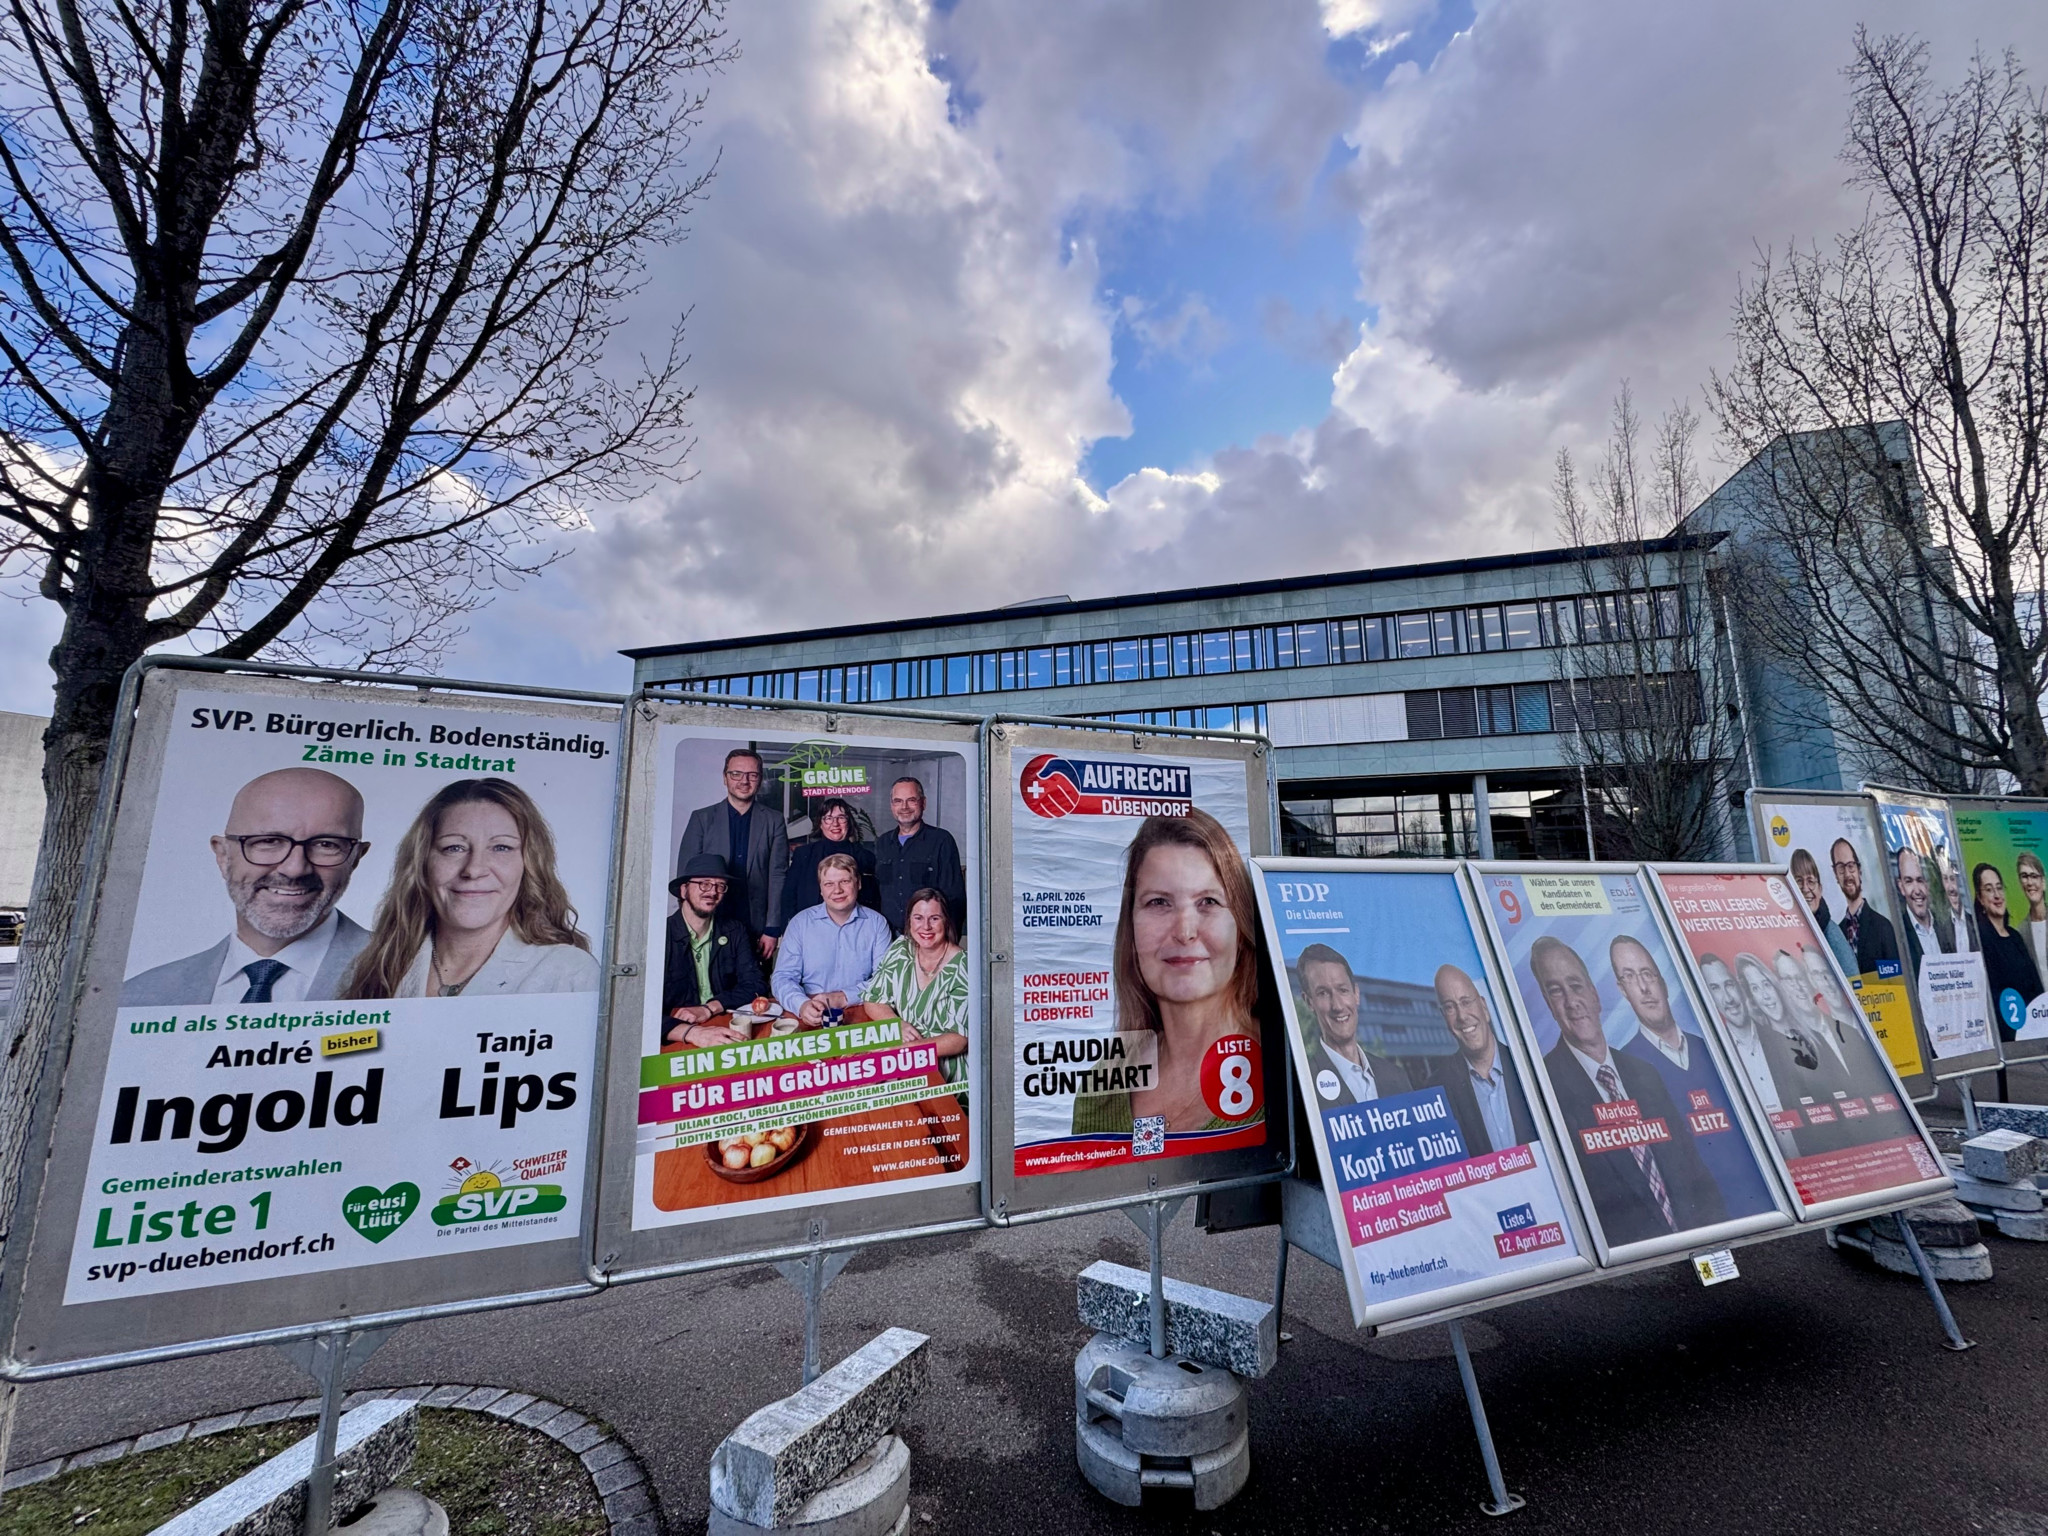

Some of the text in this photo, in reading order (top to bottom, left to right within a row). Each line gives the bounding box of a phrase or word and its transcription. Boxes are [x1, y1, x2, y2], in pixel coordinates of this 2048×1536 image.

[191, 708, 610, 759] SVP. Bürgerlich. Bodenständig.
[302, 744, 516, 772] Zäme in Stadtrat
[804, 767, 864, 784] GRÜNE
[1082, 763, 1188, 793] AUFRECHT
[803, 786, 870, 796] STADT DÜBENDORF
[1102, 795, 1190, 818] DÜBENDORF
[1772, 825, 1788, 836] EVP
[1277, 883, 1330, 902] FDP
[1493, 878, 1513, 887] Liste
[1529, 878, 1596, 887] Wählen Sie unsere
[1610, 888, 1629, 897] EDU
[1770, 882, 1782, 895] SP
[1022, 892, 1086, 901] 12. APRIL 2026
[1541, 889, 1592, 899] Kandidaten in
[1674, 897, 1700, 913] FÜR
[1700, 900, 1721, 913] EIN
[1722, 897, 1769, 912] LEBENS-
[1022, 904, 1092, 914] WIEDER IN DEN
[1285, 909, 1344, 920] Die Liberalen
[1499, 889, 1522, 924] 9
[1540, 901, 1555, 910] den
[1023, 915, 1103, 927] GEMEINDERAT
[1680, 913, 1804, 932] WERTES DÜBENDORF.
[1023, 972, 1109, 987] KONSEQUENT
[1879, 964, 1899, 975] Liste 7
[1023, 988, 1109, 1005] FREIHEITLICH
[130, 1009, 391, 1034] und als Stadtpräsident
[1023, 1006, 1093, 1022] LOBBYFREI
[2009, 1003, 2019, 1023] 2
[327, 1034, 374, 1051] bisher
[476, 1028, 554, 1055] Tanja
[670, 1022, 901, 1078] EIN STARKES TEAM
[1023, 1036, 1125, 1066] CLAUDIA
[1216, 1039, 1251, 1054] LISTE
[206, 1040, 313, 1068] André
[672, 1048, 936, 1113] FÜR EIN GRÜNES DÜBI
[1023, 1064, 1153, 1097] GÜNTHART
[1218, 1054, 1254, 1116] 8
[1319, 1081, 1337, 1089] Bisher
[439, 1063, 578, 1129] Lips
[675, 1077, 926, 1134] JULIAN CROCI, URSULA BRACK, DAVID SIEMS (BISHER)
[1690, 1094, 1709, 1110] Jan
[110, 1067, 385, 1154] Ingold
[675, 1081, 969, 1148] JUDITH STOFER, RENÉ SCHÖNENBERGER, BENJAMIN SPIELMANN
[1328, 1094, 1447, 1142] Mit Herz und
[1596, 1103, 1638, 1120] Markus
[823, 1114, 960, 1137] GEMEINDEWAHLEN 12. APRIL 2026
[1690, 1112, 1729, 1132] LEITZ
[843, 1133, 960, 1155] IVO HASLER IN DEN STADTRAT
[1583, 1118, 1668, 1150] BRECHBÜHL
[872, 1153, 960, 1173] WWW.GRÜNE-DÜBI.CH
[1025, 1146, 1127, 1167] www.aufrecht-schweiz.ch
[1340, 1129, 1462, 1182] Kopf für Dübi
[101, 1158, 343, 1195] Gemeinderatswahlen
[520, 1161, 567, 1181] QUALITÄT
[1352, 1149, 1532, 1212] Adrian Ineichen und Roger Gallati
[347, 1191, 406, 1214] Für eusi
[453, 1187, 539, 1220] SVP
[93, 1191, 272, 1249] Liste 1
[358, 1211, 402, 1229] Lüüt
[437, 1215, 558, 1237] Die Partei des Mittelstandes
[1358, 1200, 1446, 1239] in den Stadtrat
[1502, 1208, 1533, 1230] Liste 4
[1499, 1227, 1561, 1253] 12. April 2026
[87, 1232, 335, 1282] svp-duebendorf.ch
[1370, 1256, 1448, 1285] fdp-duebendorf.ch
